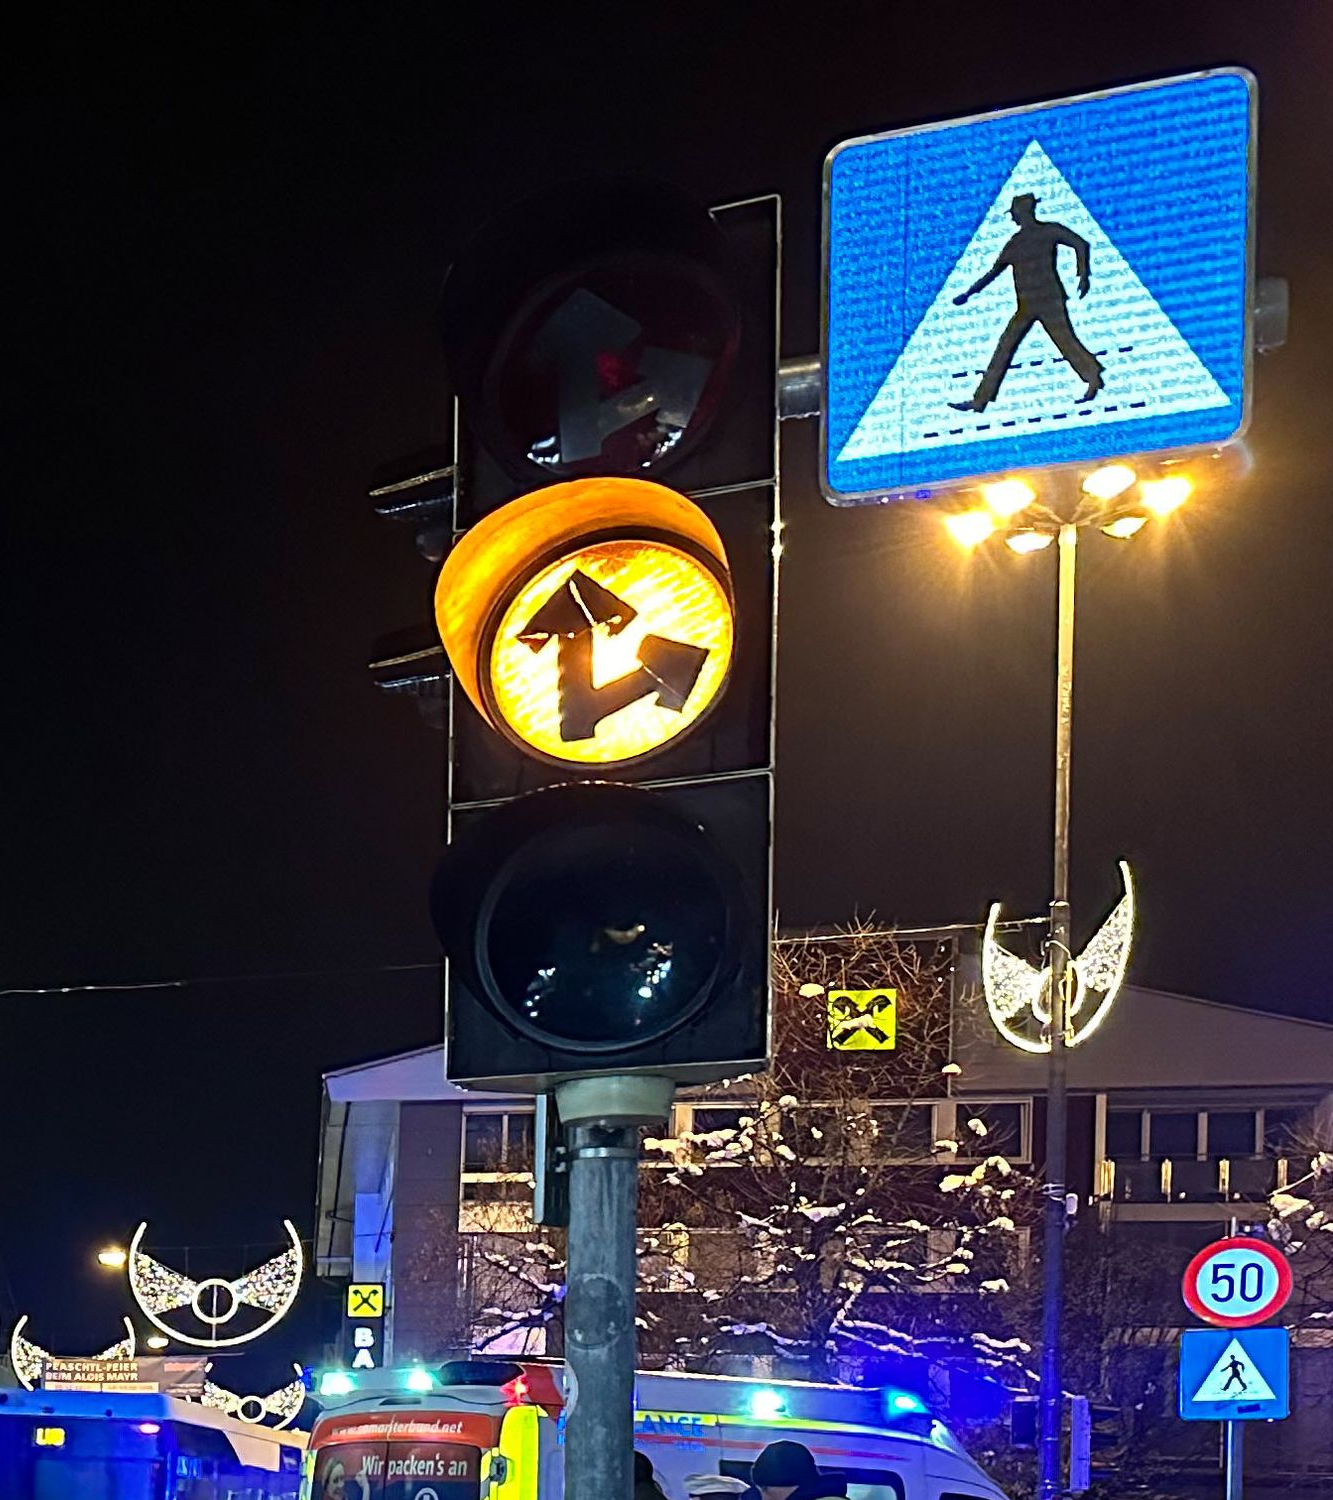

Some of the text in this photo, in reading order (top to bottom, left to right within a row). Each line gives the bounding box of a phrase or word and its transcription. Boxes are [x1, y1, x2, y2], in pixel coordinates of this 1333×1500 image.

[1211, 1262, 1264, 1303] 50
[45, 1372, 139, 1382] BEIM ALOIS MAYR
[362, 1455, 384, 1476] Wir
[448, 1460, 468, 1477] an
